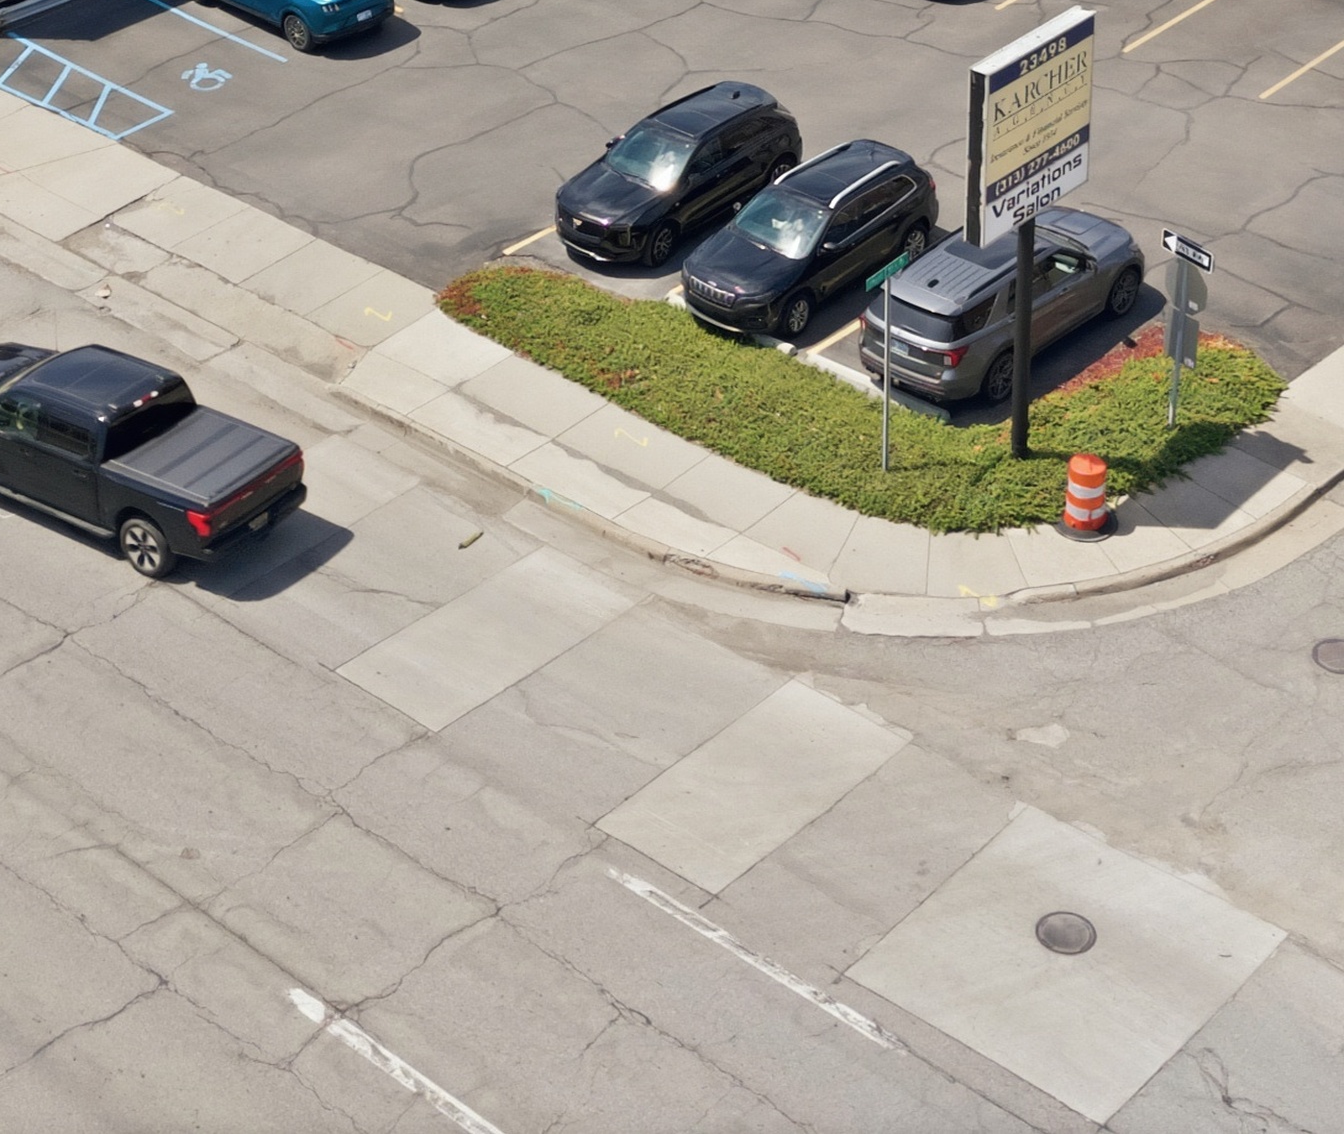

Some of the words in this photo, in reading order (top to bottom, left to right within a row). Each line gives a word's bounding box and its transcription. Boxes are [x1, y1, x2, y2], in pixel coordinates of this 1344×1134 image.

[1019, 37, 1067, 77] 23498
[994, 50, 1088, 122] KARCHER
[992, 153, 1082, 218] Variations
[995, 168, 1025, 197] (313)
[1013, 186, 1061, 226] Salon
